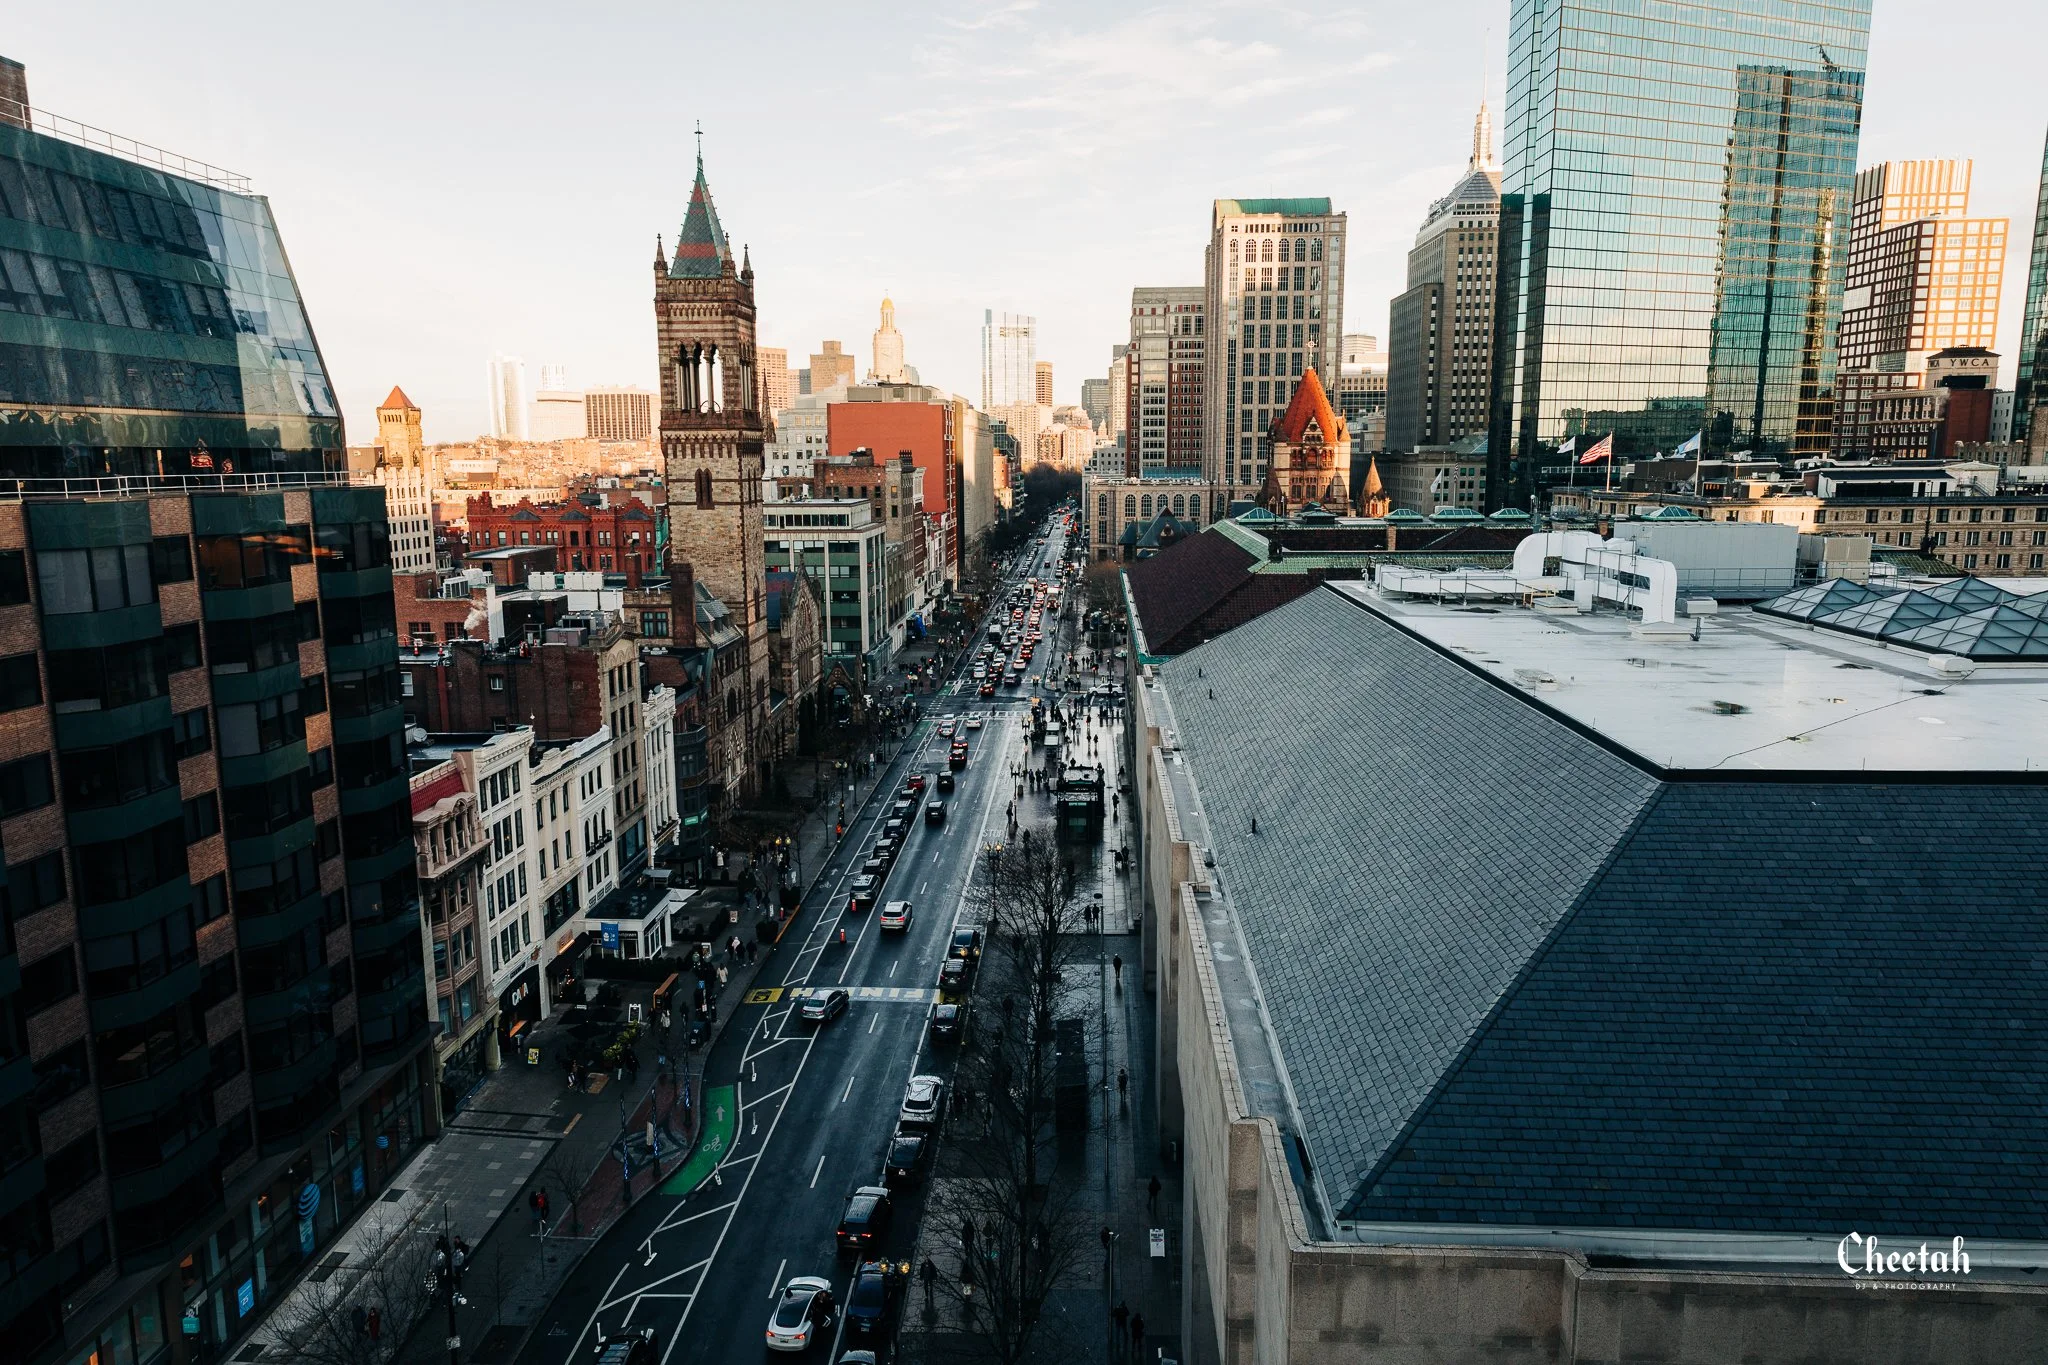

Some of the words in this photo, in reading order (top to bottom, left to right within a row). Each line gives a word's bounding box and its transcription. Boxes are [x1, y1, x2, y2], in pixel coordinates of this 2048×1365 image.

[1950, 358, 1989, 367] YWCA
[982, 828, 1004, 838] STOP
[511, 982, 529, 1006] CAVA
